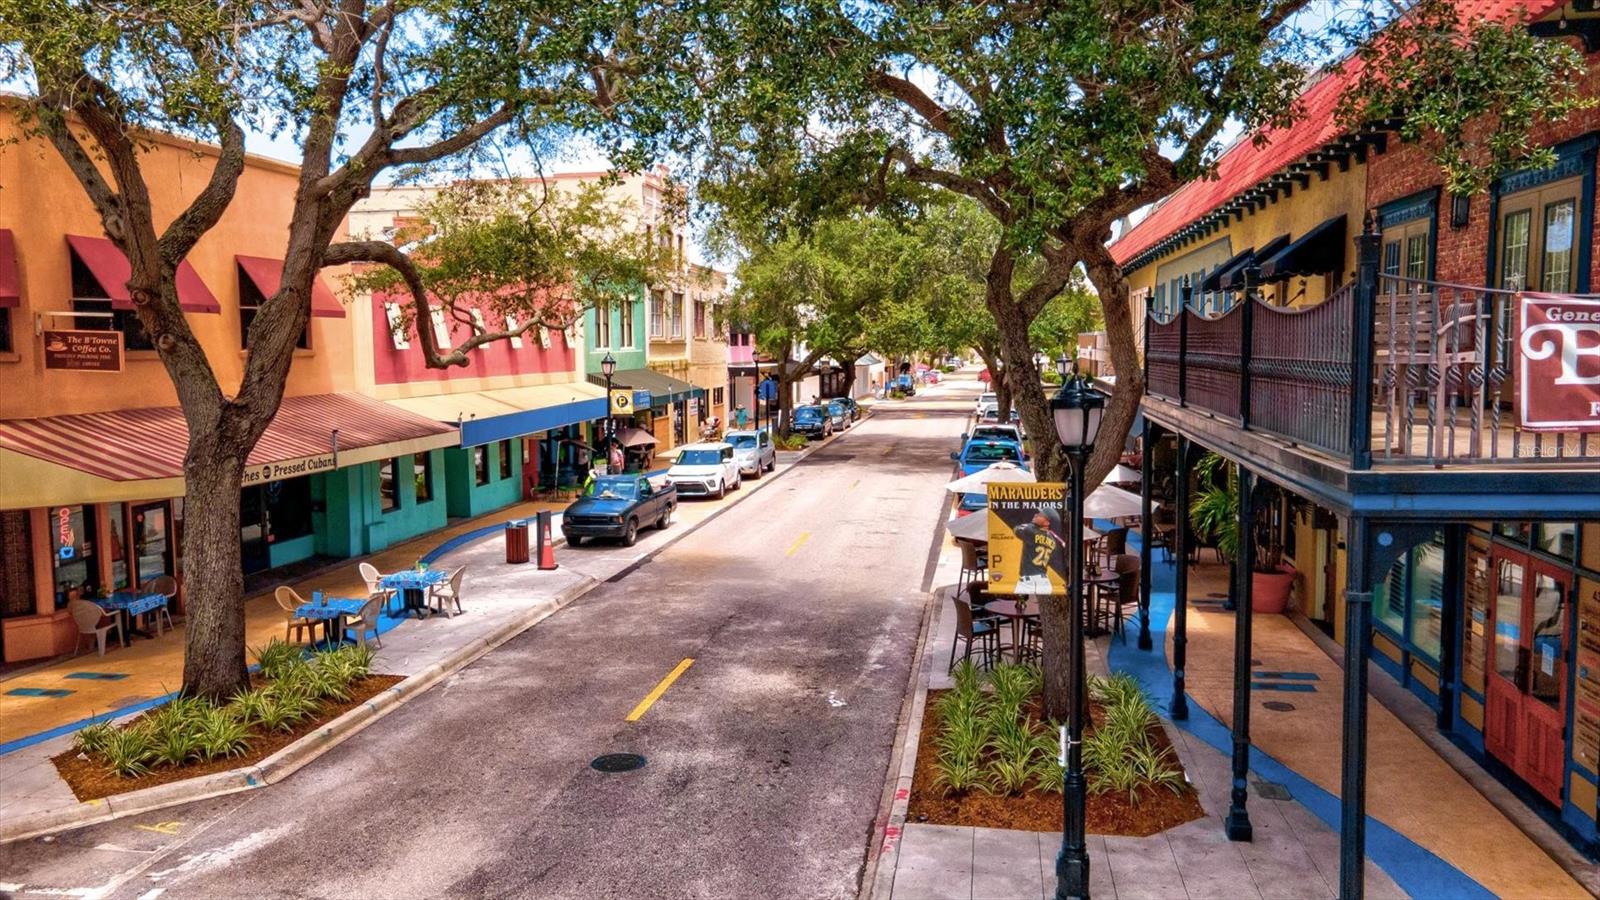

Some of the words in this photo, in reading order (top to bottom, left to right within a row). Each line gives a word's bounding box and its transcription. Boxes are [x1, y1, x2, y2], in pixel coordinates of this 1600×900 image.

[68, 336, 82, 344] The
[72, 344, 97, 353] Coffee
[274, 460, 306, 476] Pressed
[988, 486, 1063, 499] MARAUDERS
[992, 554, 1002, 568] P
